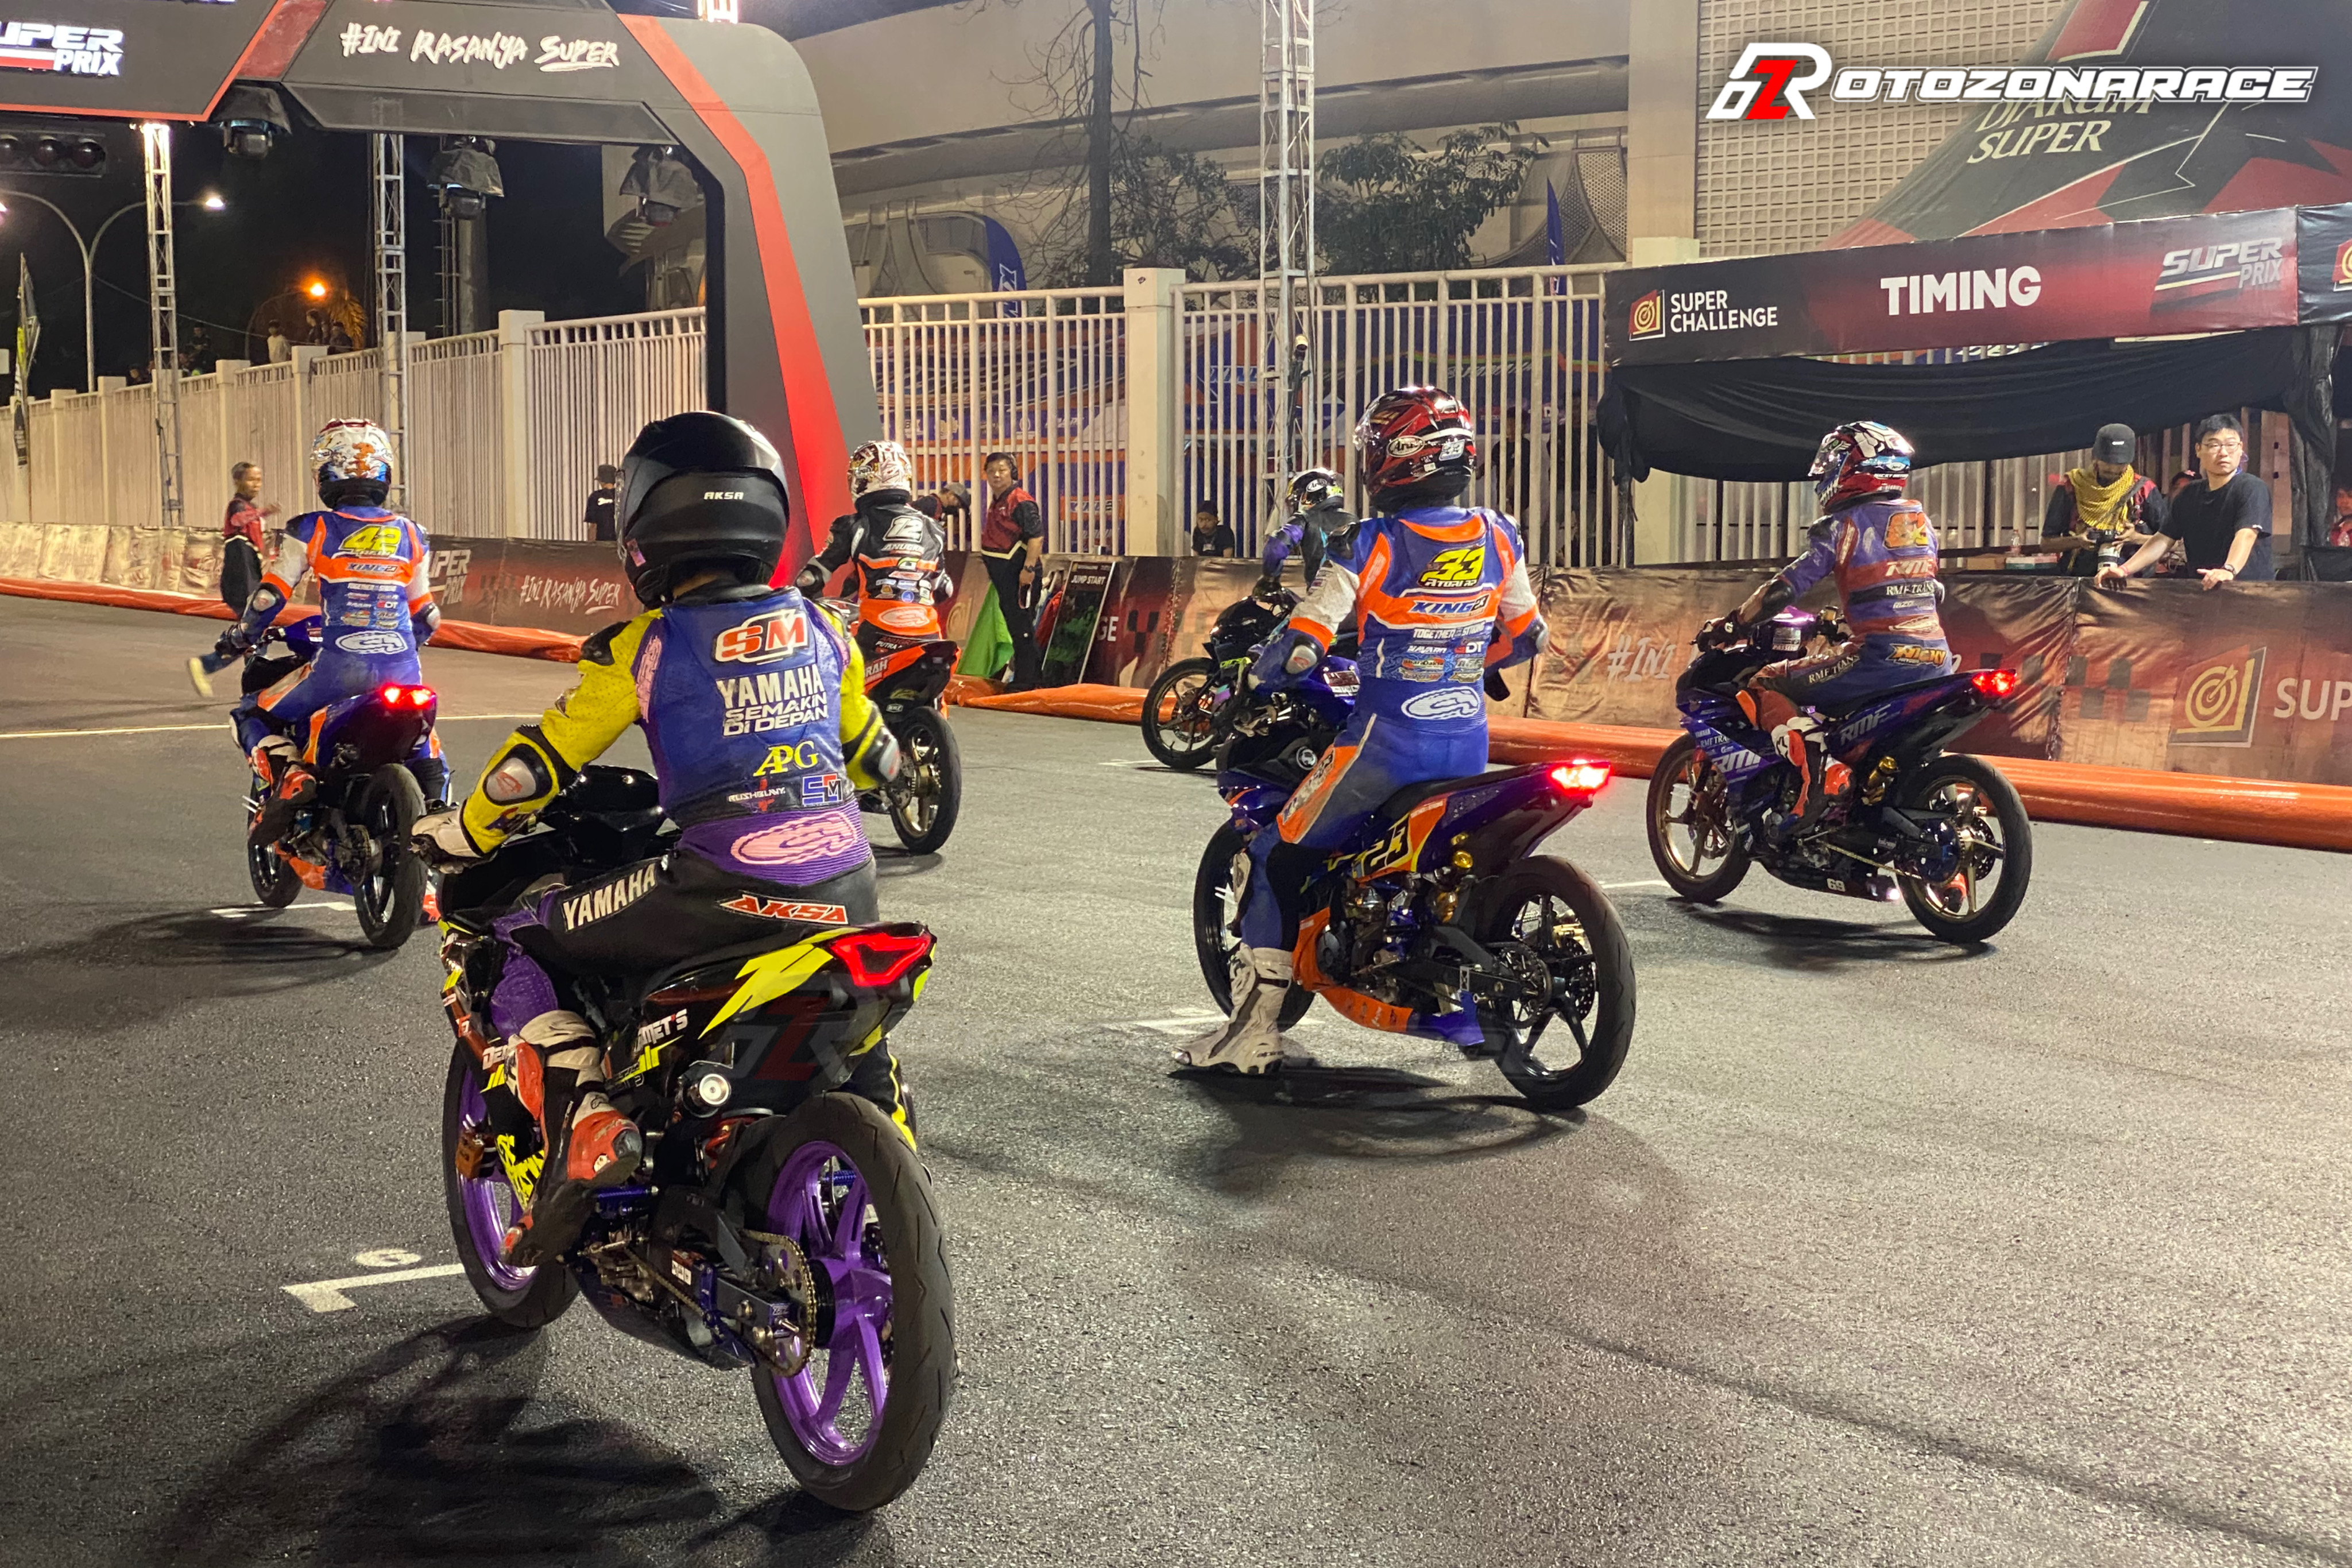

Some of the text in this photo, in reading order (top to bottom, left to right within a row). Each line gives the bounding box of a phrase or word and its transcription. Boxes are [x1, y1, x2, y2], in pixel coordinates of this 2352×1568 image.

[340, 22, 620, 69] #INI RASANYA SUPER
[53, 49, 124, 75] PRIX
[1966, 120, 2112, 164] SUPER
[2160, 237, 2284, 277] SUPER
[2238, 258, 2283, 289] PRIX
[1670, 290, 1728, 312] SUPER
[1881, 266, 2042, 316] TIMING
[1670, 306, 1778, 333] CHALLENGE
[703, 491, 744, 501] AKSA
[344, 525, 402, 555] 42
[887, 517, 923, 541] 12
[1421, 545, 1486, 582] 33
[1071, 575, 1106, 585] JUMP START
[722, 616, 807, 659] SM
[876, 640, 897, 650] PUTRA
[1413, 628, 1456, 639] TOGETHER
[1607, 634, 1677, 683] #INI
[716, 663, 825, 710] YAMAHA
[1809, 668, 1830, 683] RMF
[723, 704, 829, 737] DI DEPAN
[724, 691, 828, 725] SEMAKIN
[1839, 704, 1891, 746] RMF
[753, 741, 819, 777] APG
[562, 863, 657, 931] YAMAHA
[1827, 878, 1846, 892] 69
[720, 895, 849, 924] AKSA
